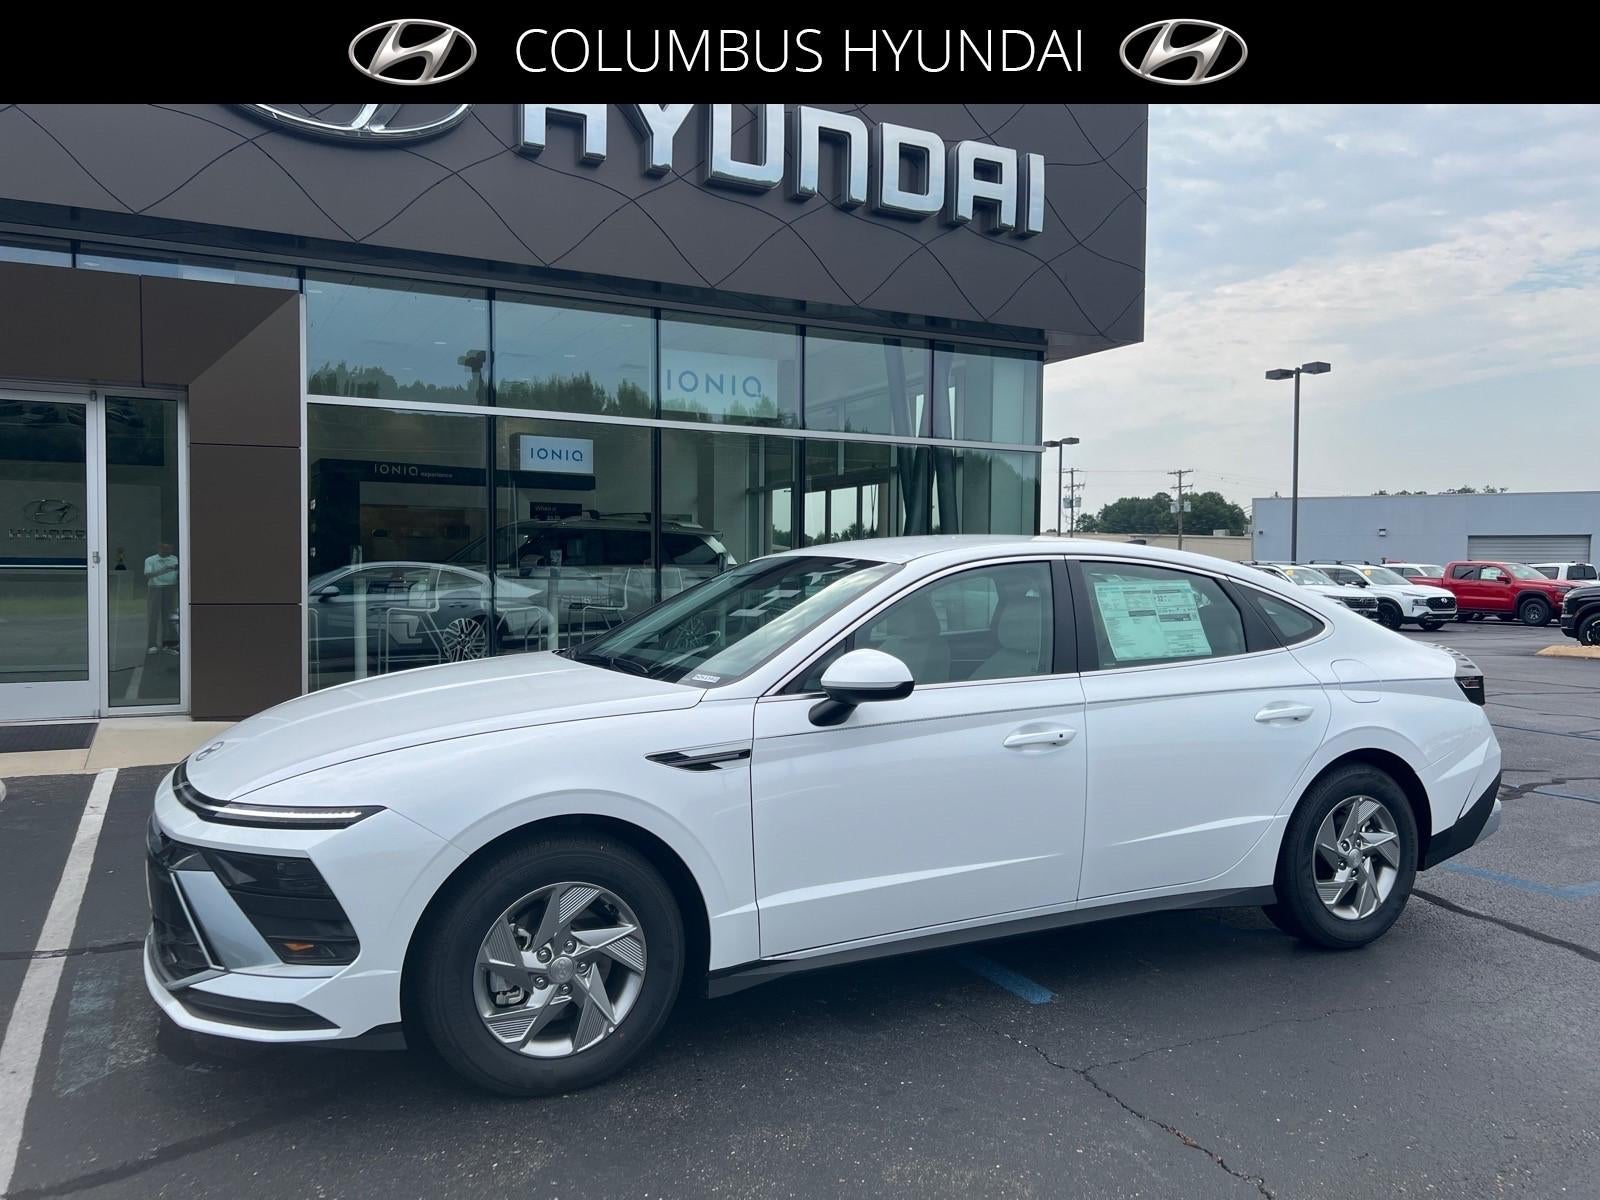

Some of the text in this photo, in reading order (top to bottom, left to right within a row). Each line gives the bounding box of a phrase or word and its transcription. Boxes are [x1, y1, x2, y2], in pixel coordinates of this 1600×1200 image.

[666, 368, 763, 398] IONIQ
[530, 447, 584, 462] IONIQ
[373, 463, 419, 477] IONIQ
